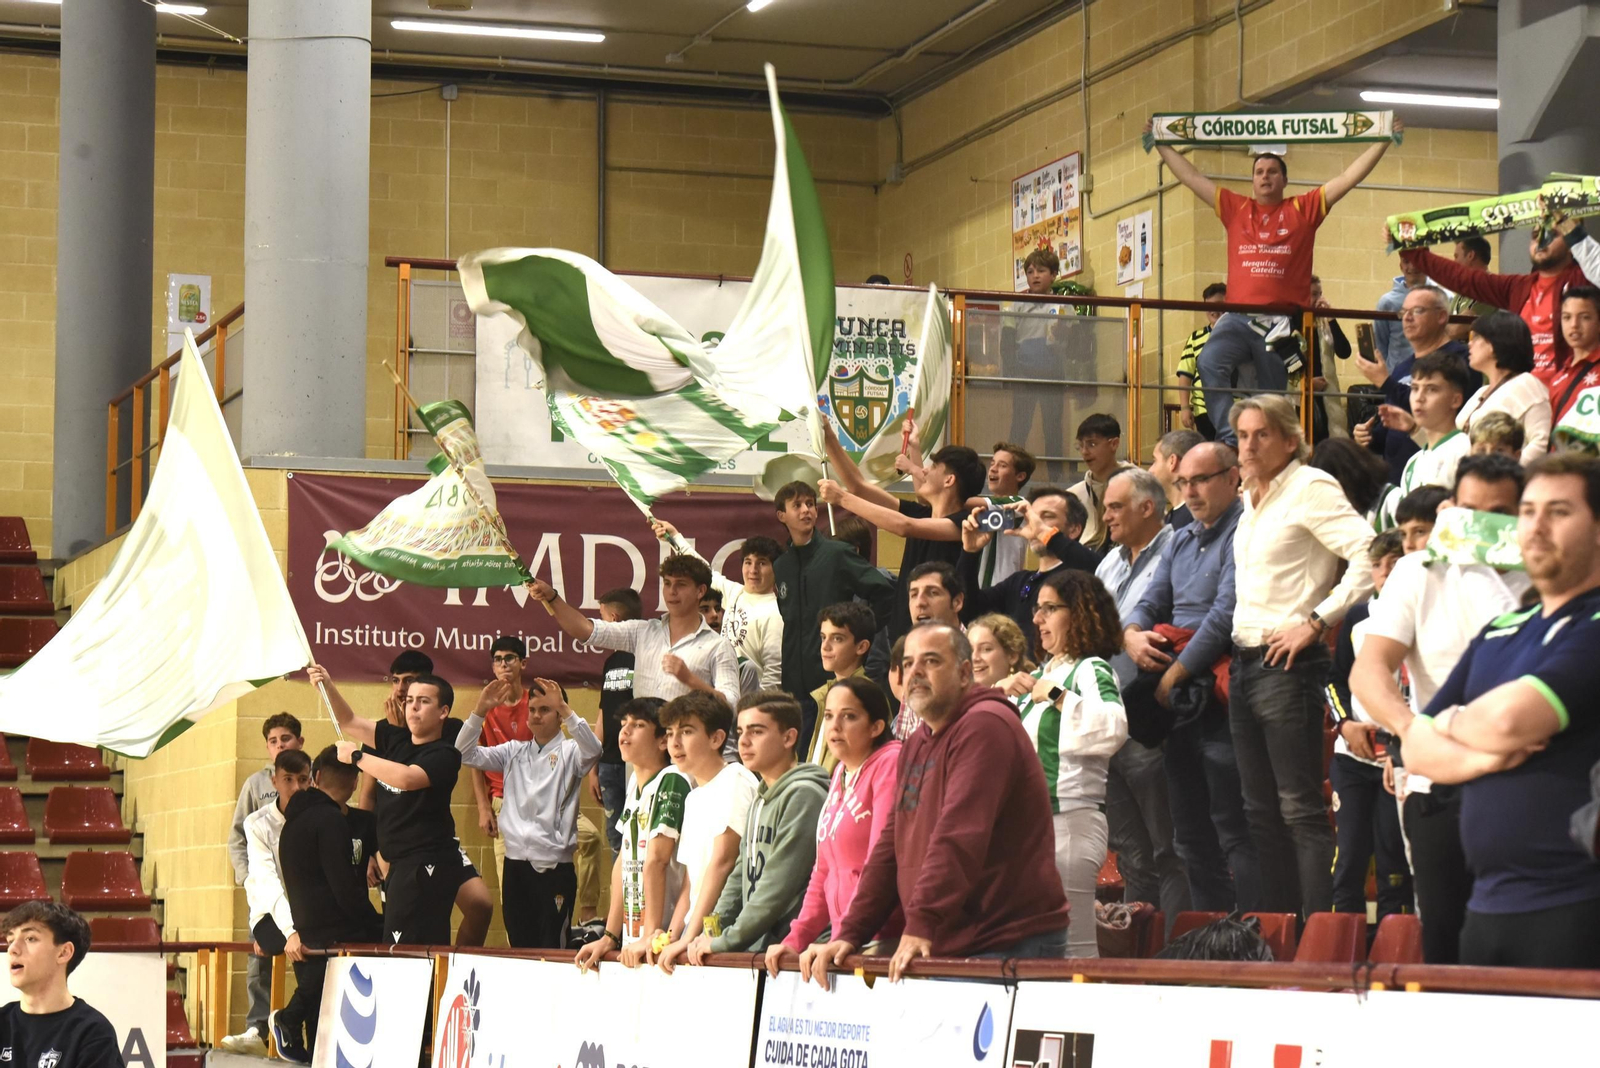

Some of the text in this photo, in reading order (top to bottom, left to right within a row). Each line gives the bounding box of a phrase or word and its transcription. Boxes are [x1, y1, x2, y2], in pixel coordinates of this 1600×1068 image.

[1202, 117, 1338, 136] CÓRDOBA FUTSAL
[838, 316, 906, 338] UNCA
[315, 622, 425, 649] Instituto
[433, 626, 563, 658] Muniipal
[769, 1016, 870, 1042] EL AGUA ES TU MEJOR DEPORTE
[765, 1039, 868, 1068] CUIDA DE CADA GOTA
